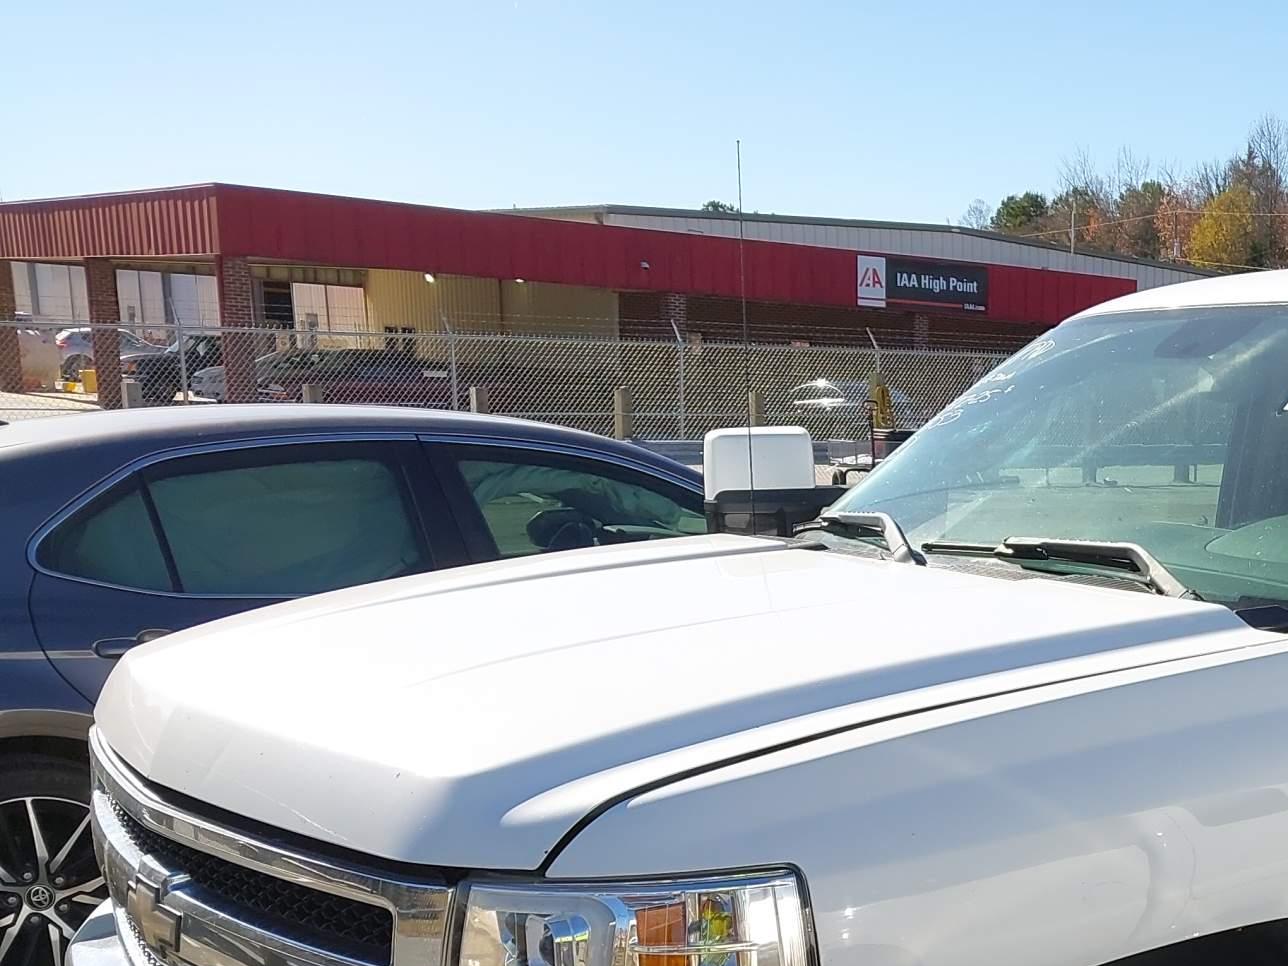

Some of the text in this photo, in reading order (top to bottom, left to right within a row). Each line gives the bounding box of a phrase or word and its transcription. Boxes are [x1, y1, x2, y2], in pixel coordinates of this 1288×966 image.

[896, 272, 978, 293] IAA High Point
